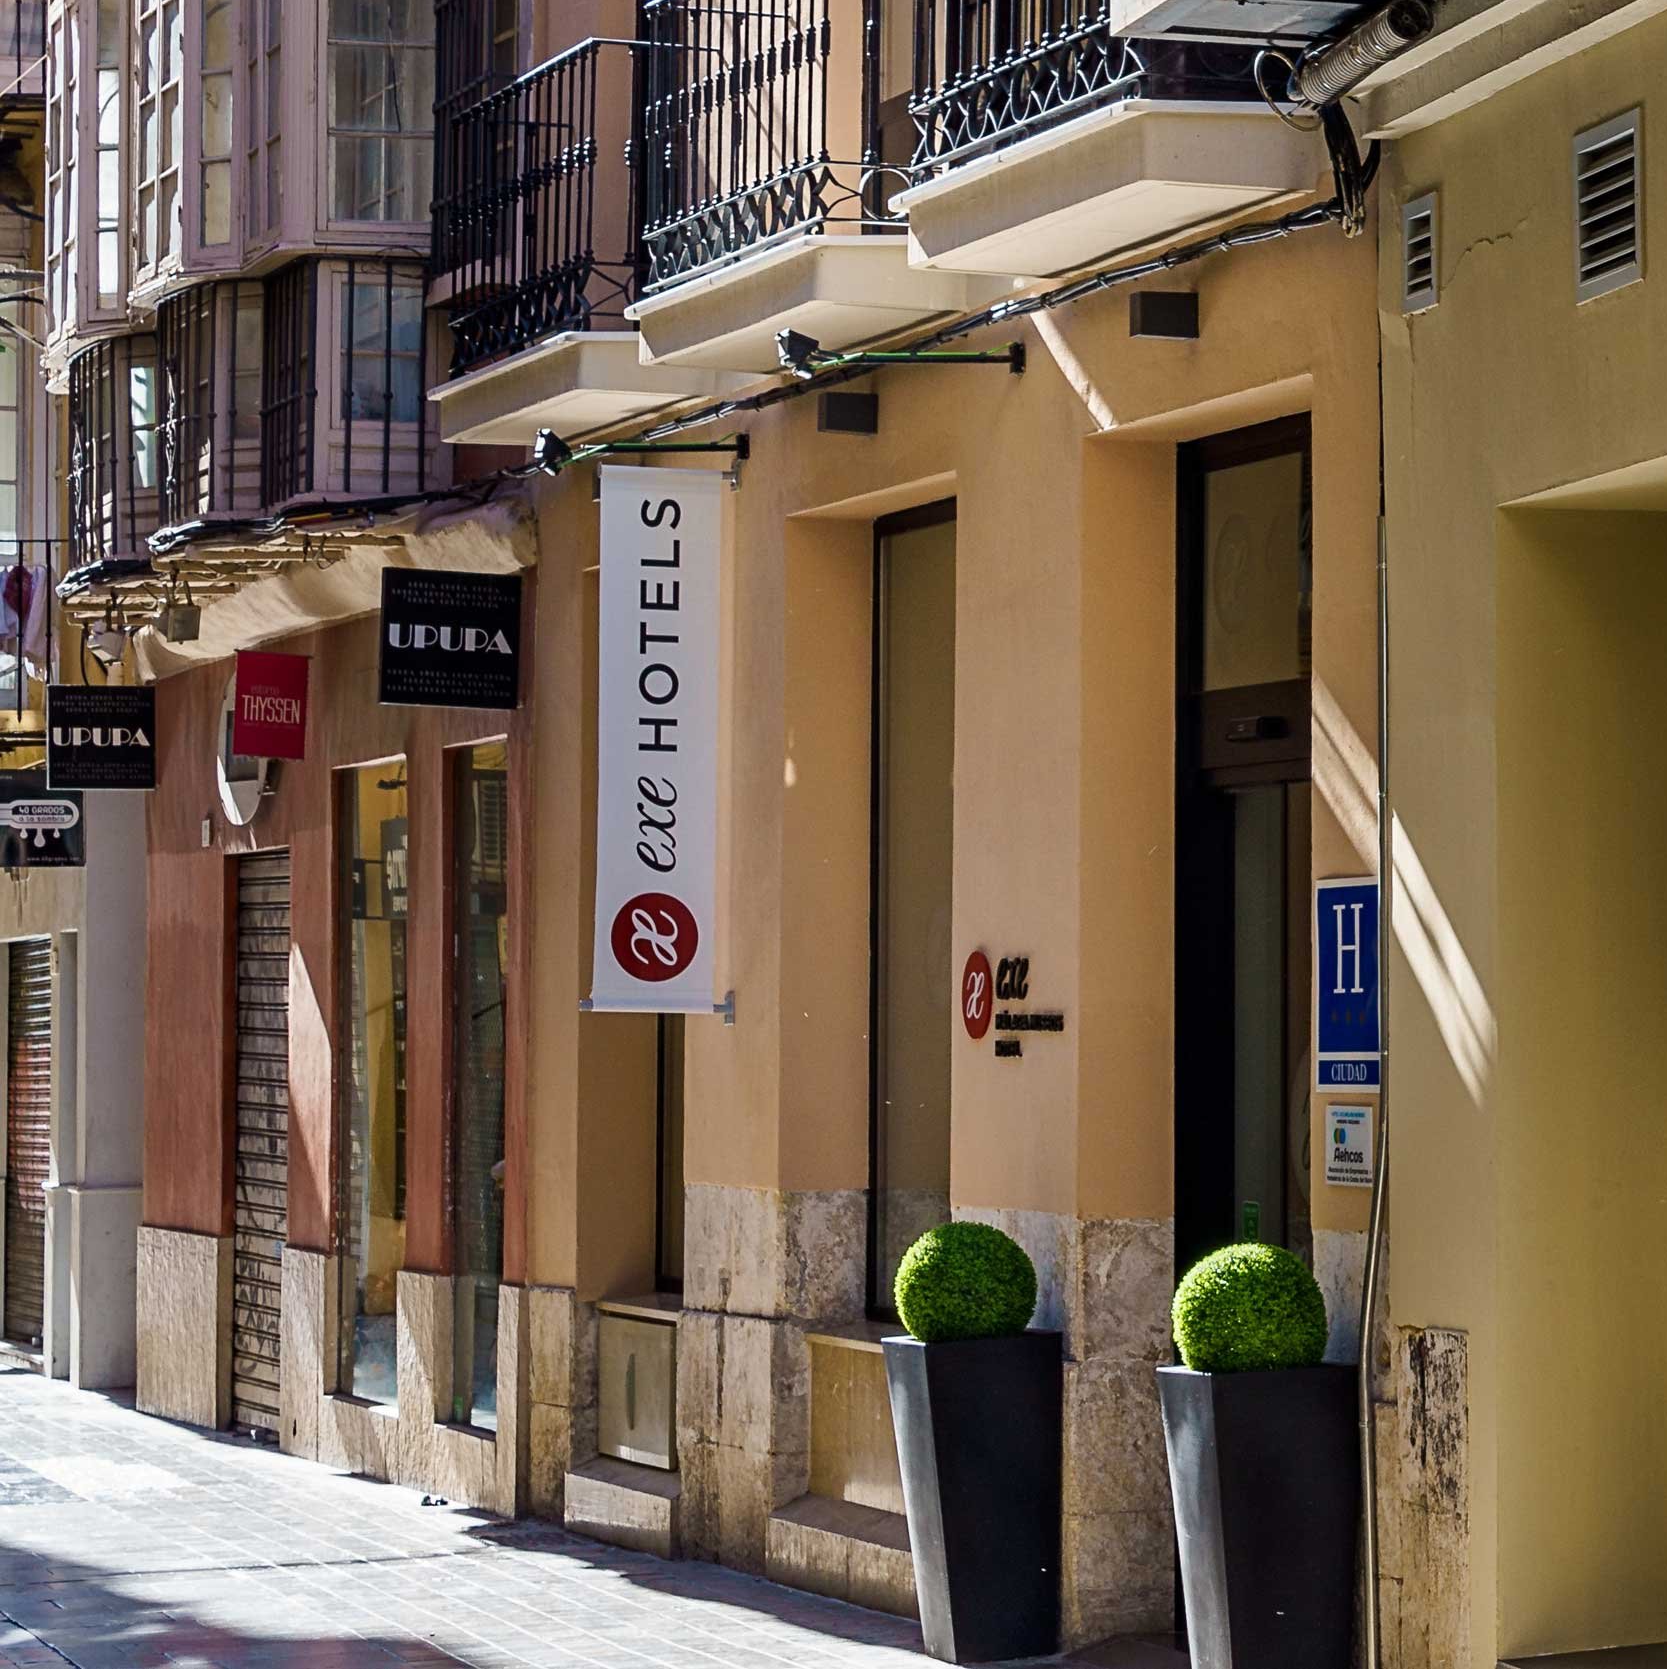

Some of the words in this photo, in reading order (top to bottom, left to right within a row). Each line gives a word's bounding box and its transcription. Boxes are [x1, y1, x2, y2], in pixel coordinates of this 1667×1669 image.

[388, 622, 513, 655] UPUPA
[638, 497, 682, 753] HOTELS
[241, 694, 301, 725] THYSSEN
[52, 726, 151, 747] UPUPA
[18, 806, 30, 814] 40
[31, 806, 65, 814] GRADOS
[636, 775, 678, 873] exe
[1332, 903, 1364, 994] H
[1331, 1062, 1368, 1082] CIUDAD
[1333, 1147, 1364, 1164] Aehcos
